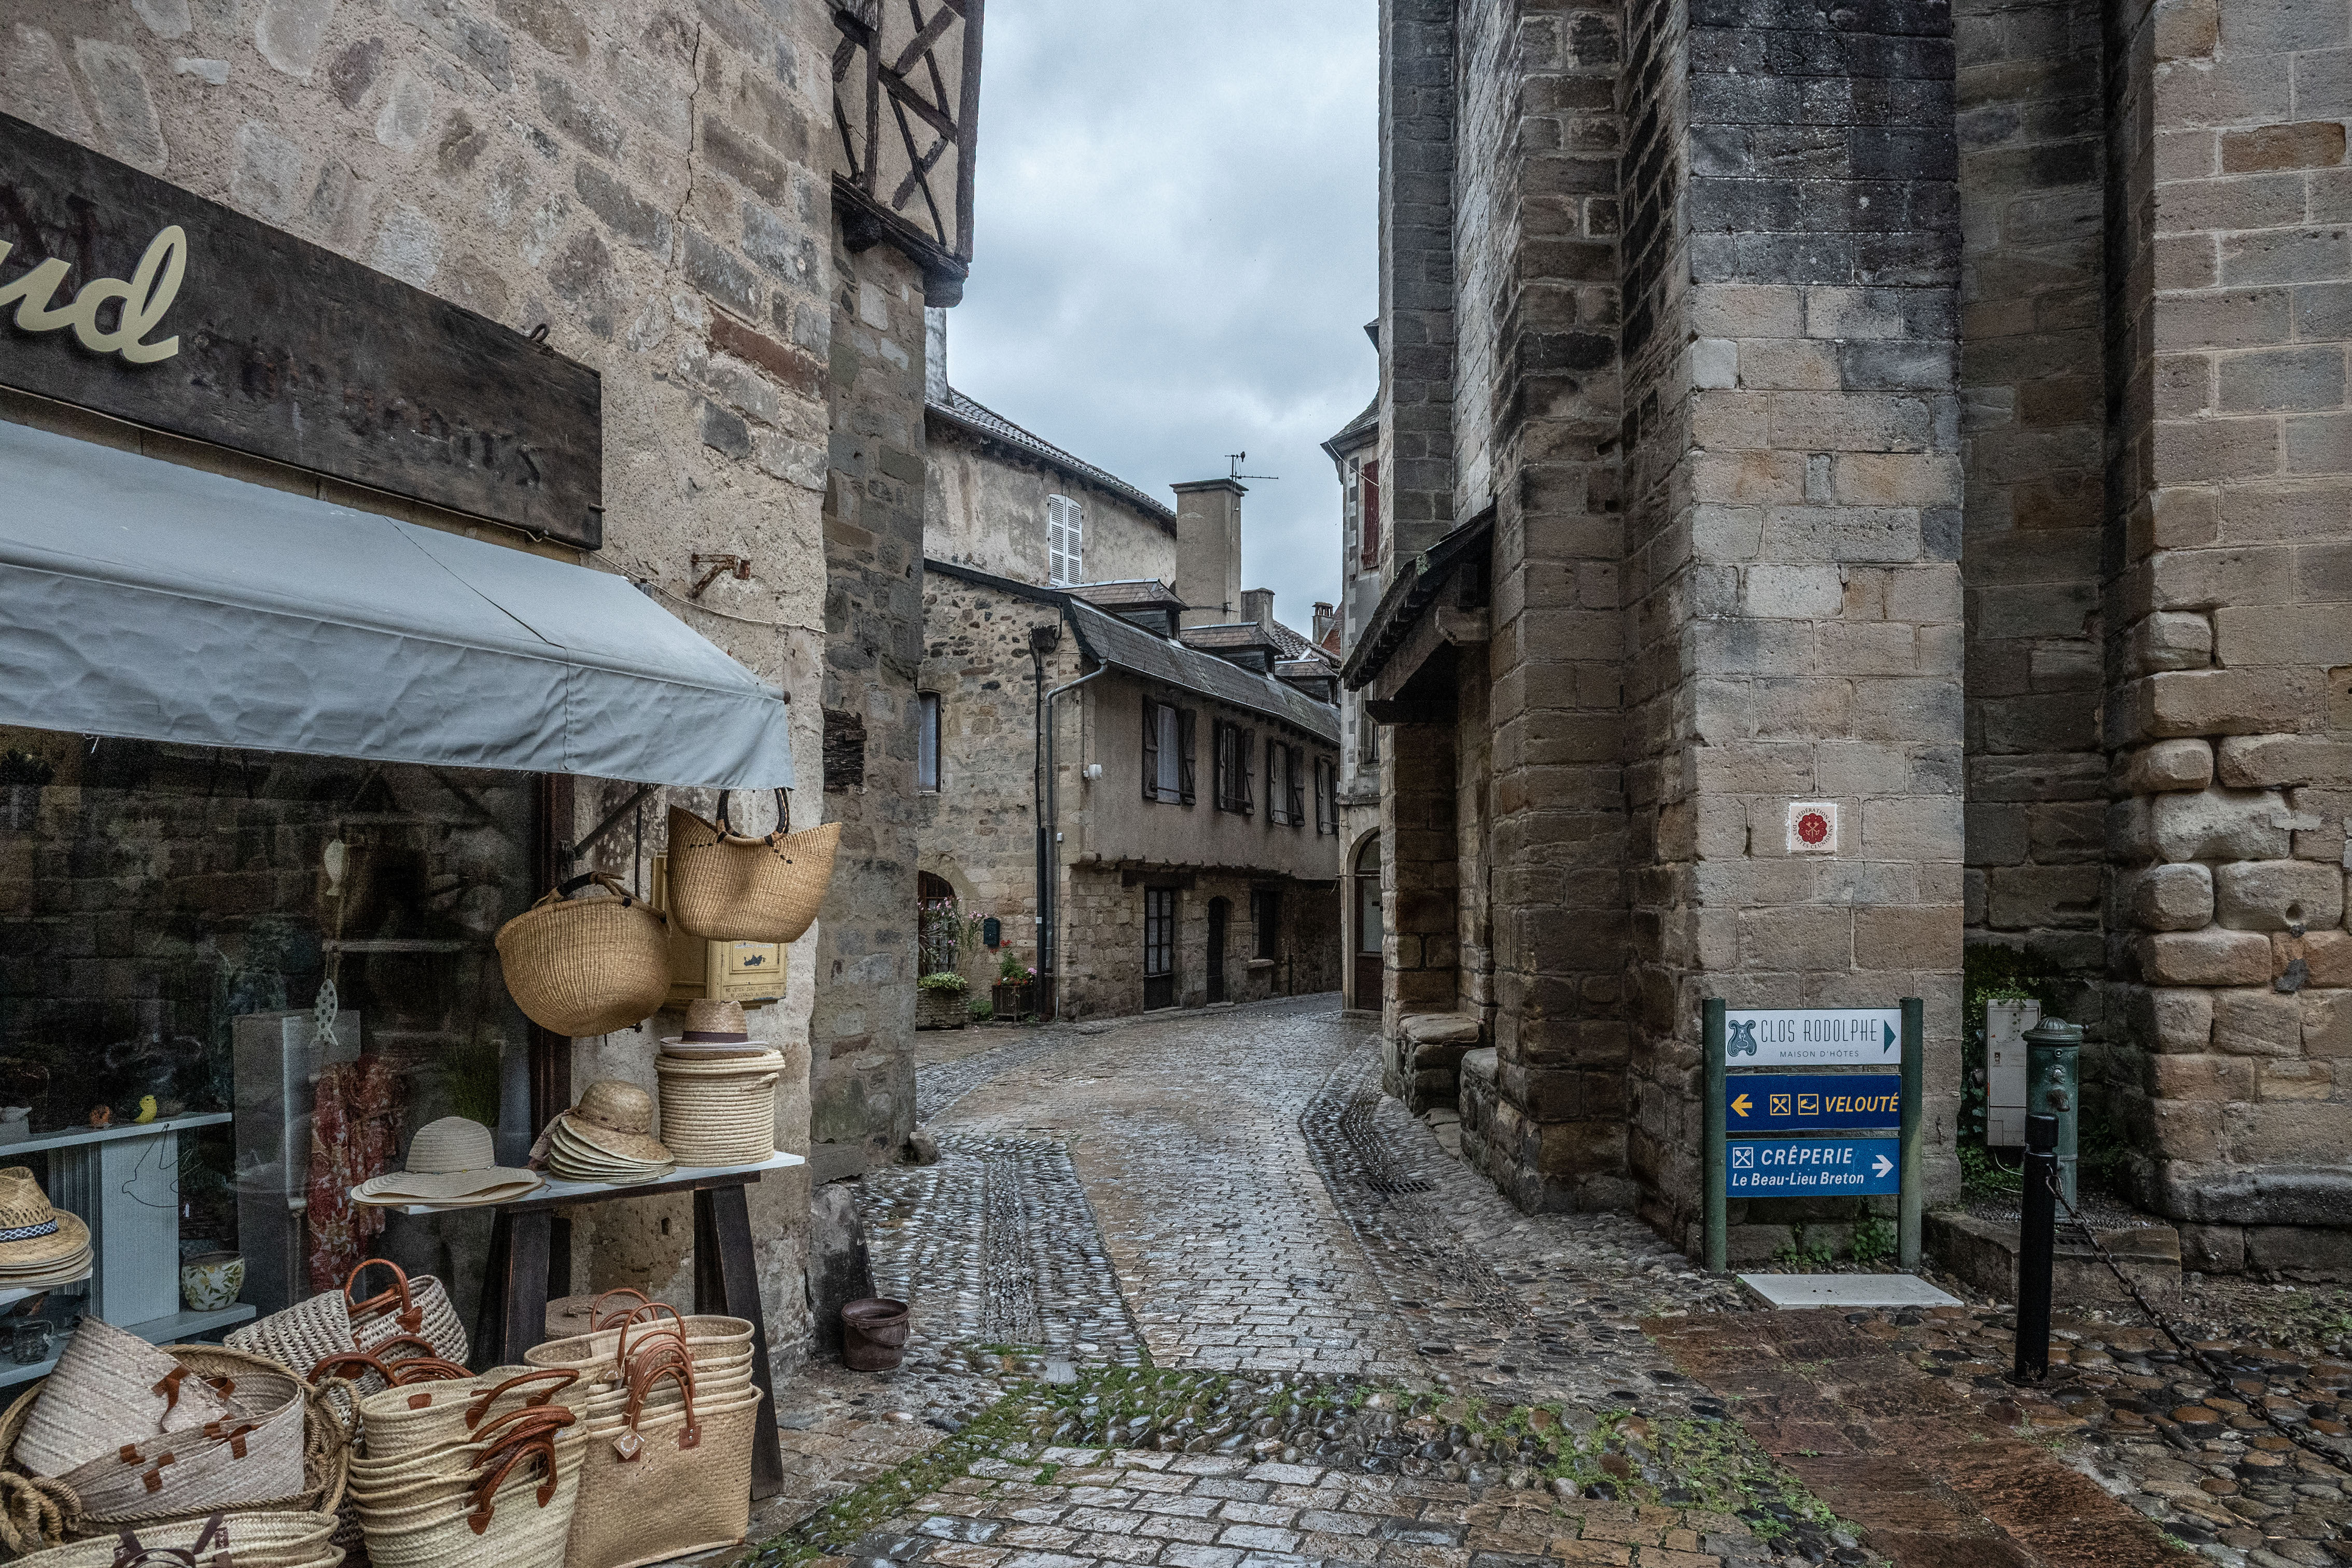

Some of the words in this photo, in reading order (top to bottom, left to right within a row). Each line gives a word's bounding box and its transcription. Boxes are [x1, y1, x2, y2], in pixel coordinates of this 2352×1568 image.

[1795, 836, 1809, 848] SITES
[1810, 825, 1833, 849] CLUNISIENS
[1761, 1019, 1795, 1043] CLOS
[1803, 1019, 1878, 1042] RODOLPHE
[1820, 1049, 1859, 1058] D'HÔTES
[1825, 1093, 1899, 1113] VELOUTÉ
[1761, 1145, 1853, 1166] CRÊPERIE
[1732, 1173, 1747, 1186] Le
[1751, 1172, 1817, 1186] Beau-Lieu
[1820, 1171, 1864, 1185] Breton
